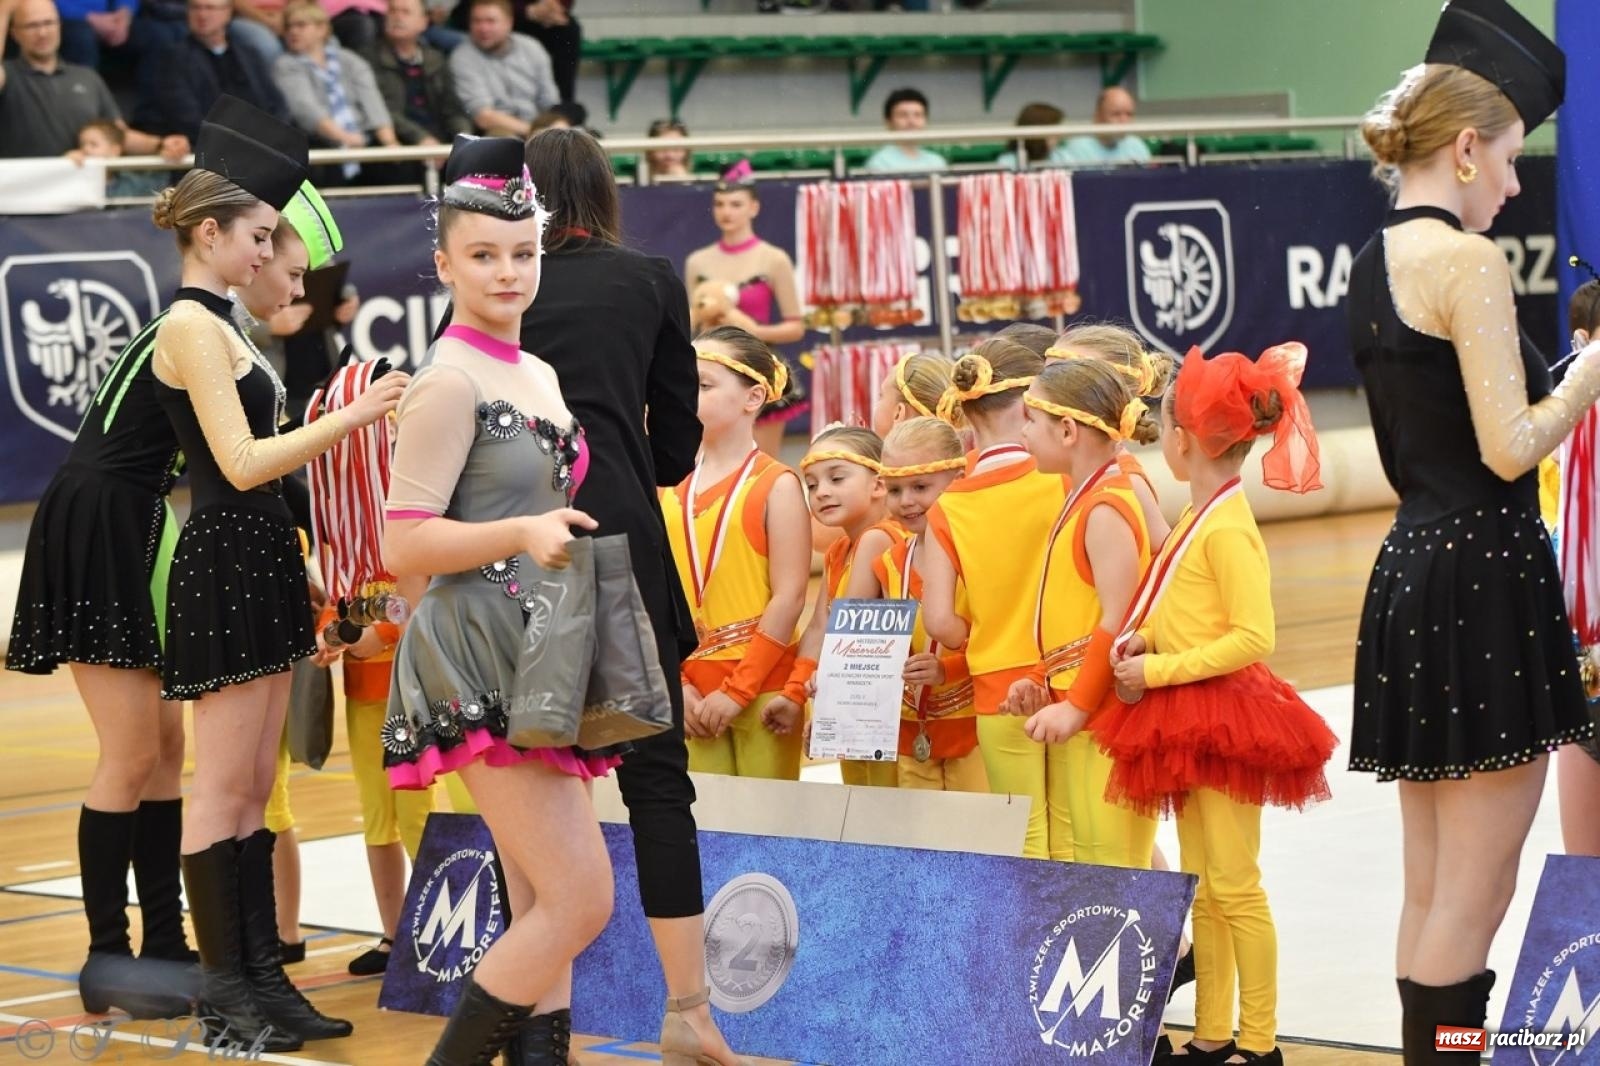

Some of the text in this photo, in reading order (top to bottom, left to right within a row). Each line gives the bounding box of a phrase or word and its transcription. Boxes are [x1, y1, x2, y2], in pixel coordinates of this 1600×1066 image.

[834, 609, 911, 631] DYPLOM
[850, 663, 880, 671] MIEJSCE
[433, 848, 482, 879] SPORTOWY
[418, 876, 480, 949] M
[1053, 905, 1121, 936] SPORTOWY
[728, 913, 762, 972] 2
[1038, 935, 1121, 1021] M
[1069, 937, 1156, 1057] MAŻORETEK
